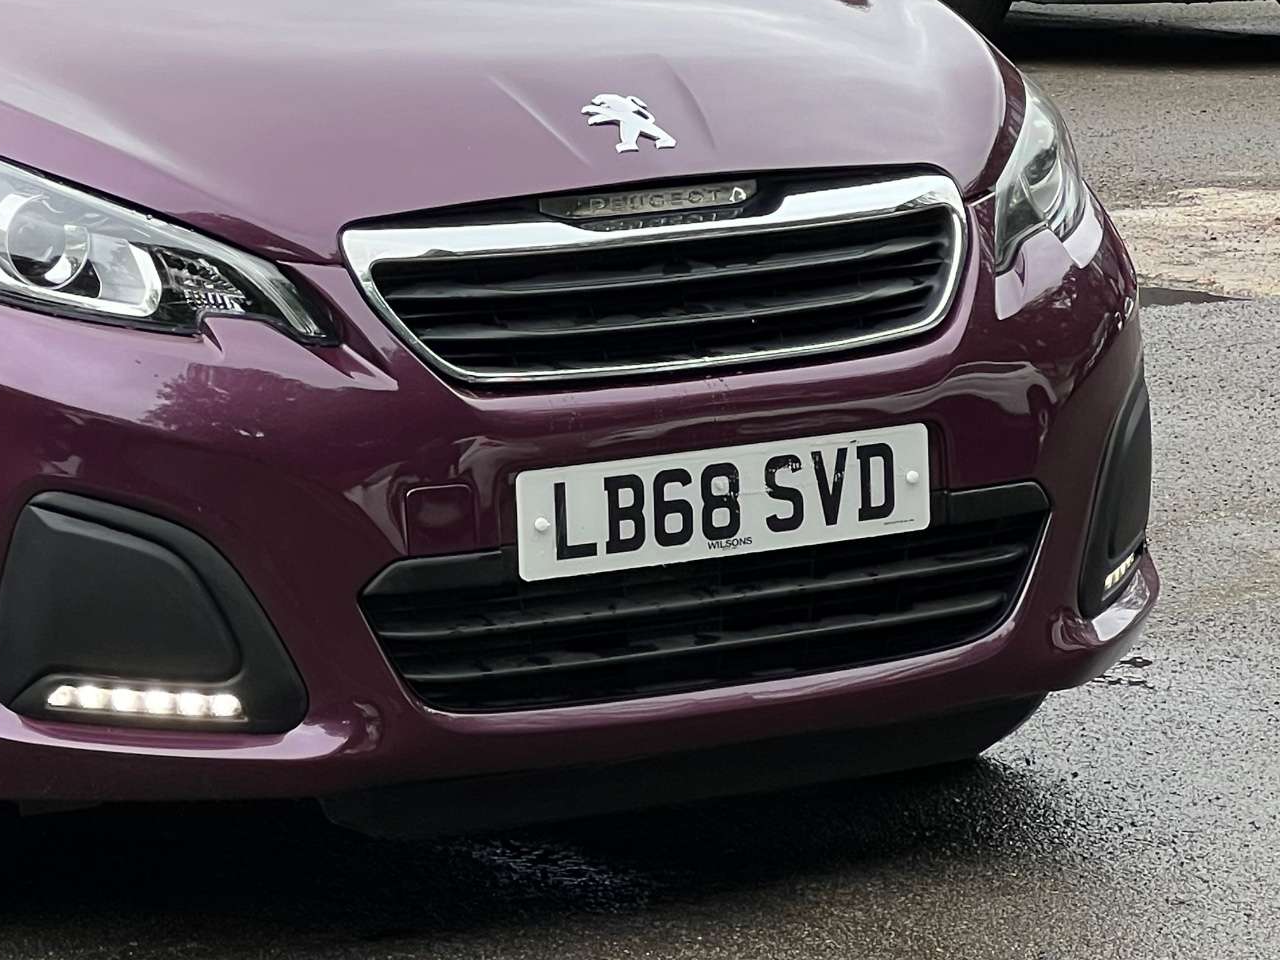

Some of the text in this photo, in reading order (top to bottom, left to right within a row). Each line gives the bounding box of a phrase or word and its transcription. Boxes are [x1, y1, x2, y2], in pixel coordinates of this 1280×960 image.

[589, 189, 720, 211] PEUGEOT
[553, 442, 894, 561] LB68 SVD
[707, 536, 753, 551] WILSONS
